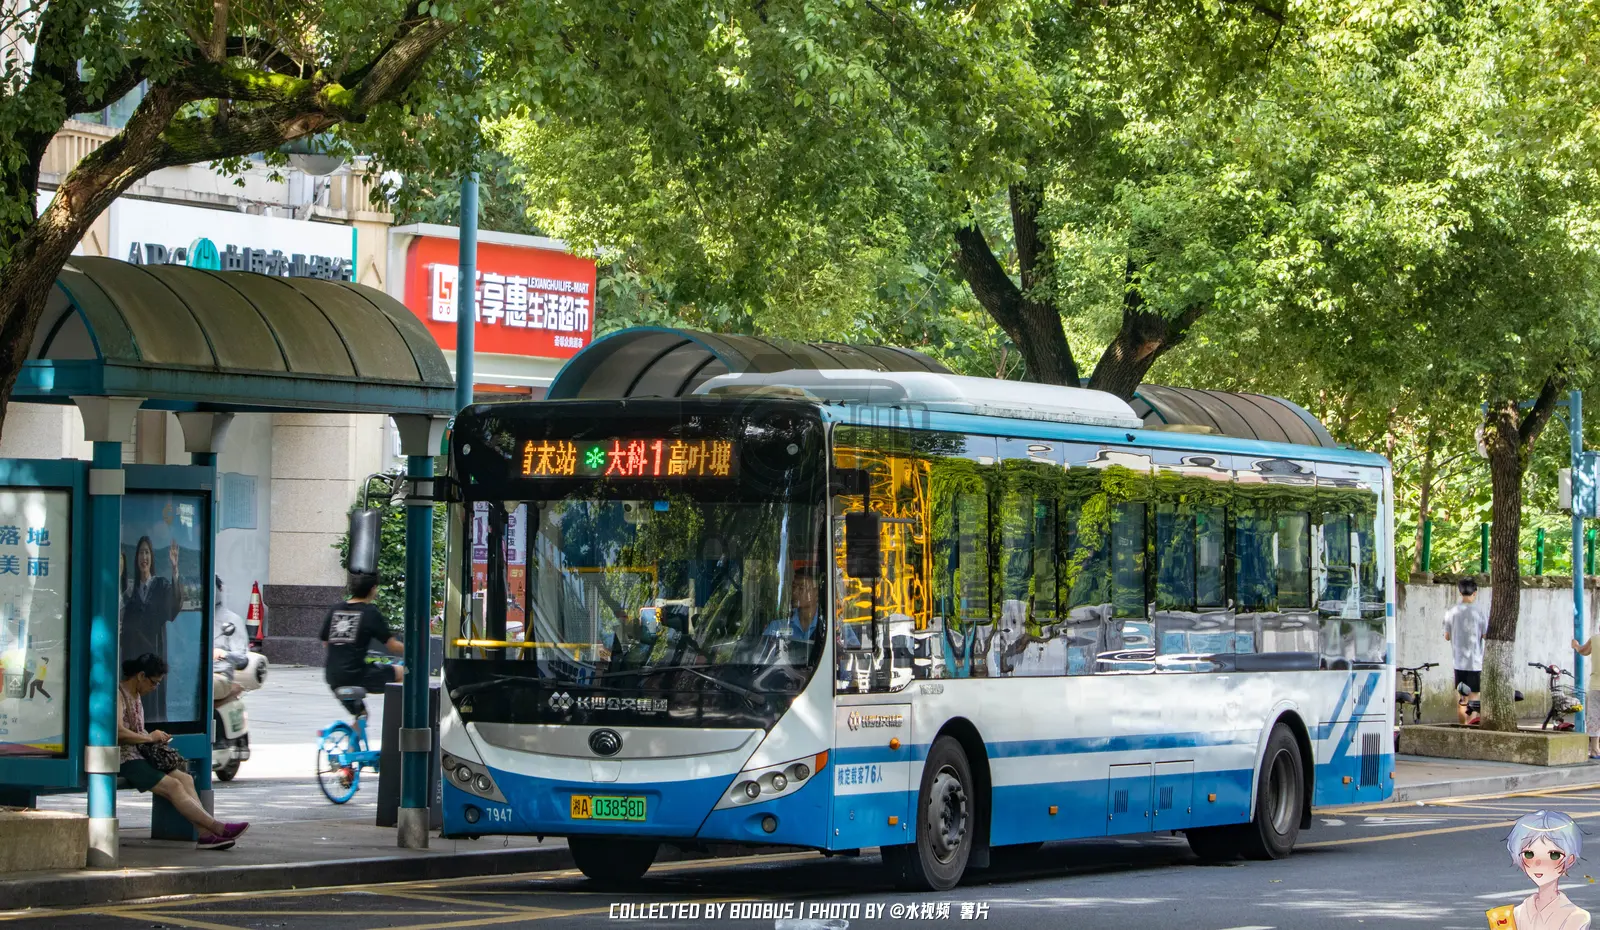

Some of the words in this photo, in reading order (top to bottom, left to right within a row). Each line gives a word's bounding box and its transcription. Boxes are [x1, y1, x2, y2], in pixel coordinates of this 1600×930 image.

[667, 440, 731, 475] 高叶塘
[0, 525, 51, 546] 落地
[0, 555, 49, 577] 美丽
[486, 807, 512, 822] 7947
